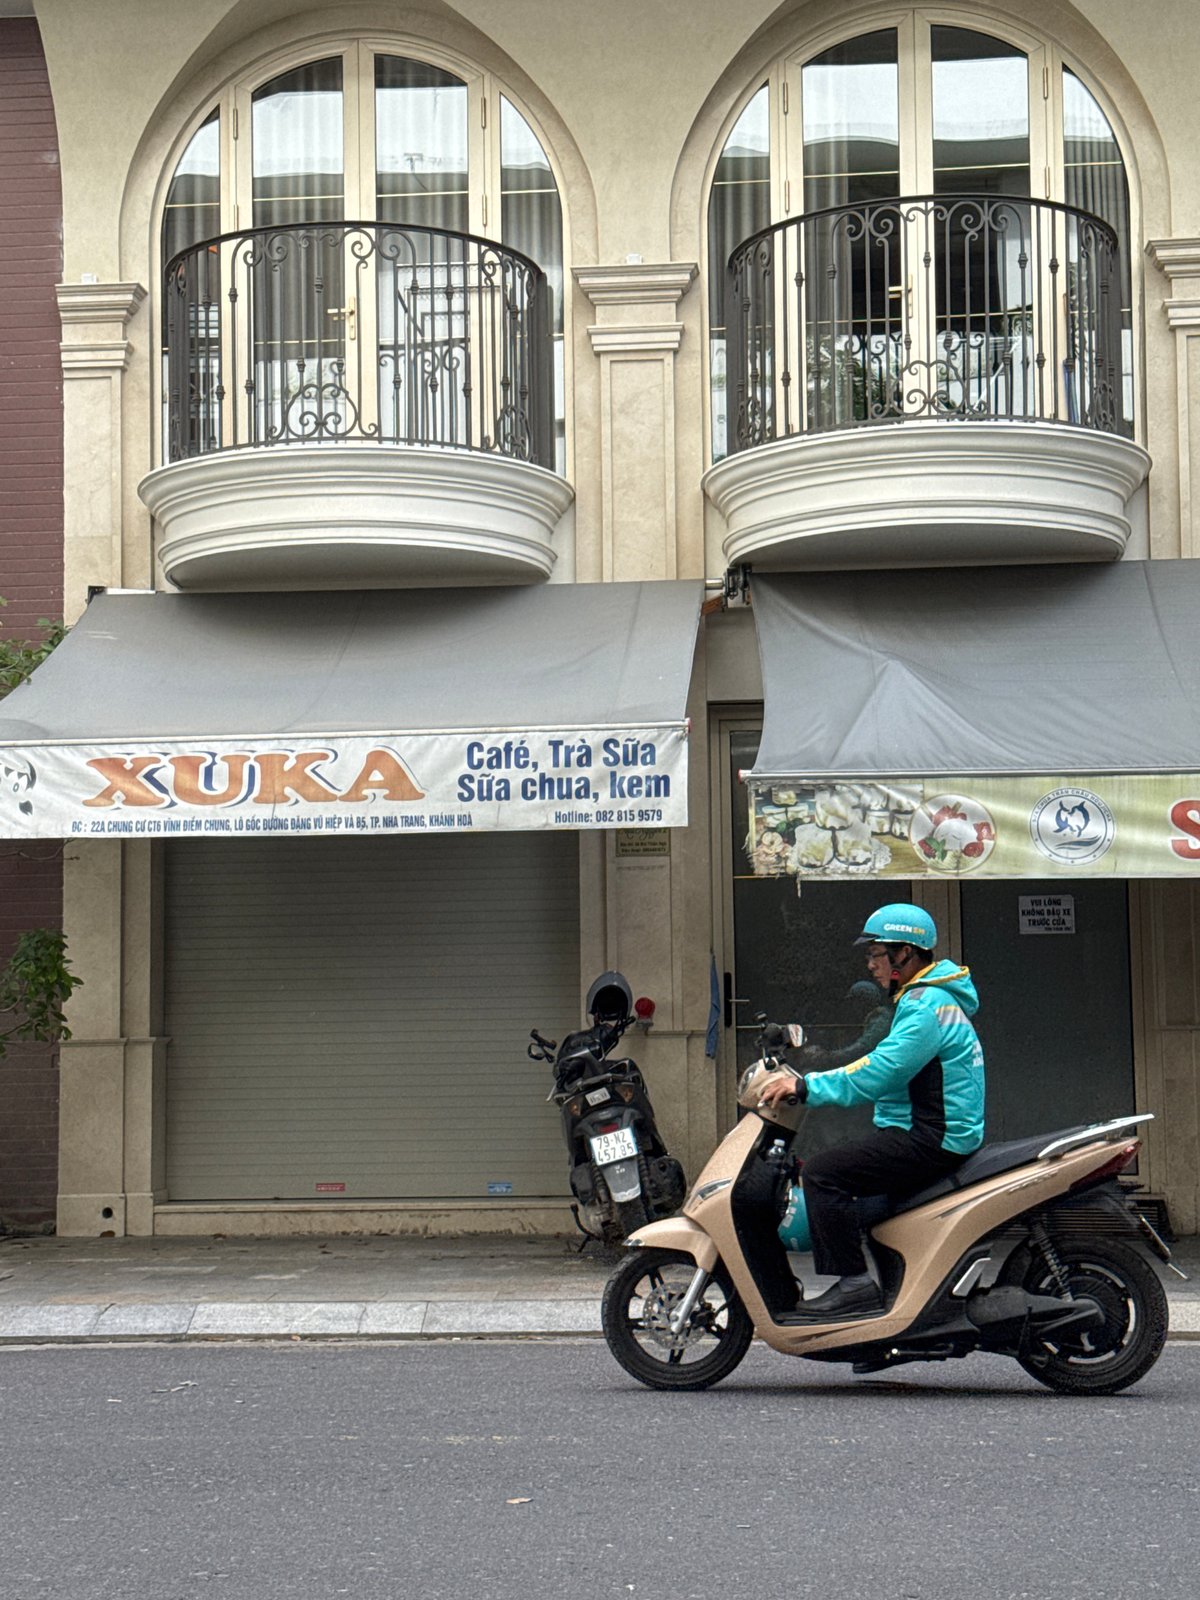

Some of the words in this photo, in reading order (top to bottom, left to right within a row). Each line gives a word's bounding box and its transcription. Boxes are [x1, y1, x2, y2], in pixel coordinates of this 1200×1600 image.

[466, 740, 538, 771] Café,
[548, 739, 592, 768] Trà
[602, 738, 656, 767] Sữa
[82, 746, 427, 809] XUKA
[457, 773, 511, 802] Sữa
[521, 772, 599, 802] chua,
[609, 771, 671, 799] kem
[90, 820, 105, 832] 22A
[107, 820, 133, 832] CHUNG
[135, 819, 147, 832] CƯ
[147, 820, 161, 832] CT6
[204, 819, 233, 832] CHUNG,
[370, 816, 381, 828] TP.
[382, 816, 399, 828] NHA
[400, 815, 427, 829] TRANG,
[429, 811, 455, 827] KHÁNH
[554, 810, 593, 824] Hotline:
[595, 809, 614, 822] 082
[617, 809, 635, 822] 815
[637, 808, 663, 822] 9579
[1062, 908, 1072, 916] XE
[883, 923, 912, 933] GREEN
